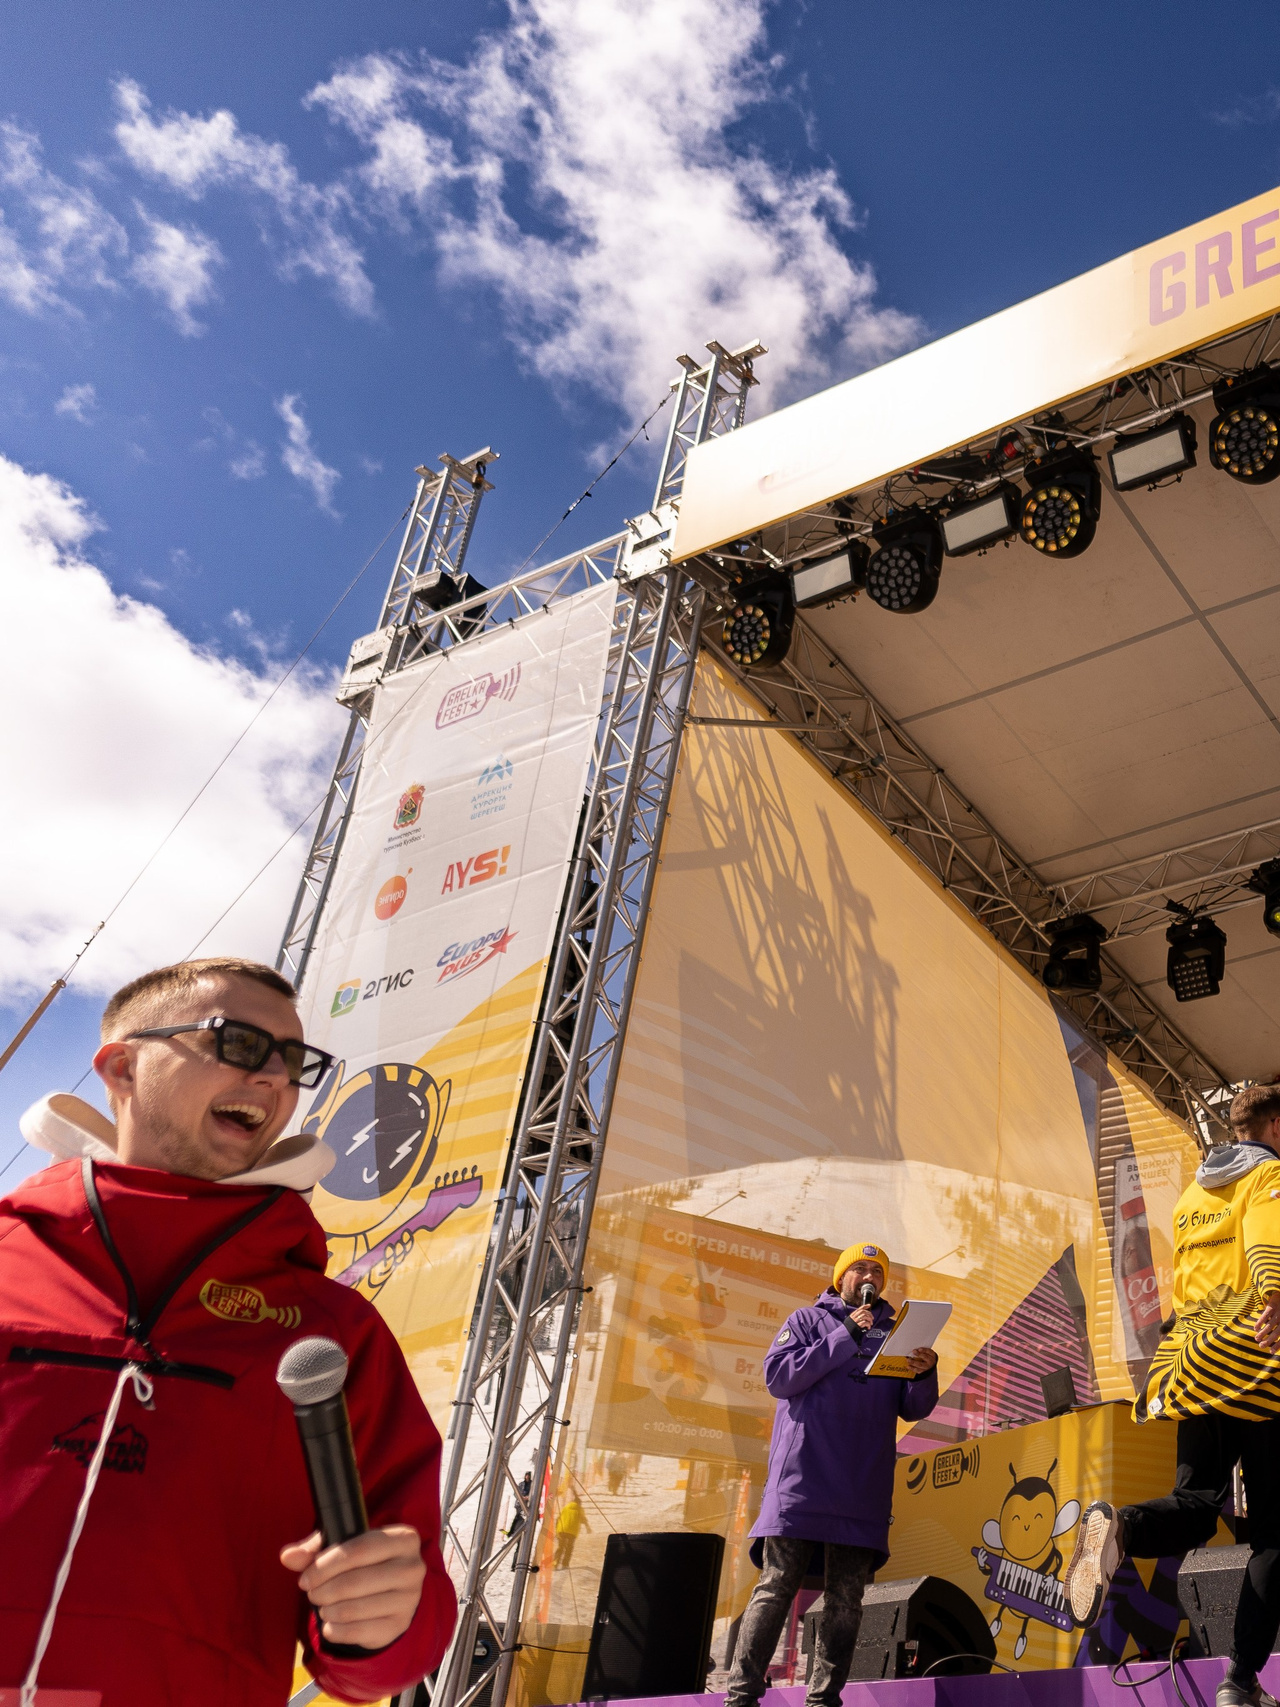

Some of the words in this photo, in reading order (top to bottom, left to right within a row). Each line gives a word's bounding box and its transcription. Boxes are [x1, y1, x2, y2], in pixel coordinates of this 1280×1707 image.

[446, 680, 487, 708] GRELKA
[441, 700, 470, 723] FEST
[470, 803, 506, 820] ШЕРЕГЕШ
[473, 795, 507, 810] КУРОРТА
[441, 844, 512, 896] AYS!
[362, 968, 415, 1001] 2ГИС
[1126, 1158, 1176, 1173] ВЫБИРАЙ
[1128, 1167, 1172, 1183] ЛУЧШЕЕ!
[1191, 1207, 1232, 1227] билай
[662, 1228, 766, 1263] СОГРЕВАЕМ
[770, 1253, 781, 1266] В
[785, 1255, 834, 1278] ШЕРЕГ
[909, 1283, 923, 1298] 10
[1128, 1266, 1174, 1301] Cola
[210, 1295, 241, 1317] FEST
[212, 1285, 260, 1309] GRELKA
[736, 1317, 780, 1334] квартир
[742, 1380, 767, 1394] Dj-se
[642, 1422, 650, 1431] с
[653, 1421, 682, 1434] 10:00
[683, 1427, 697, 1437] до
[699, 1427, 723, 1440] 0:00
[936, 1452, 960, 1470] GRELKA
[936, 1468, 953, 1484] FEST
